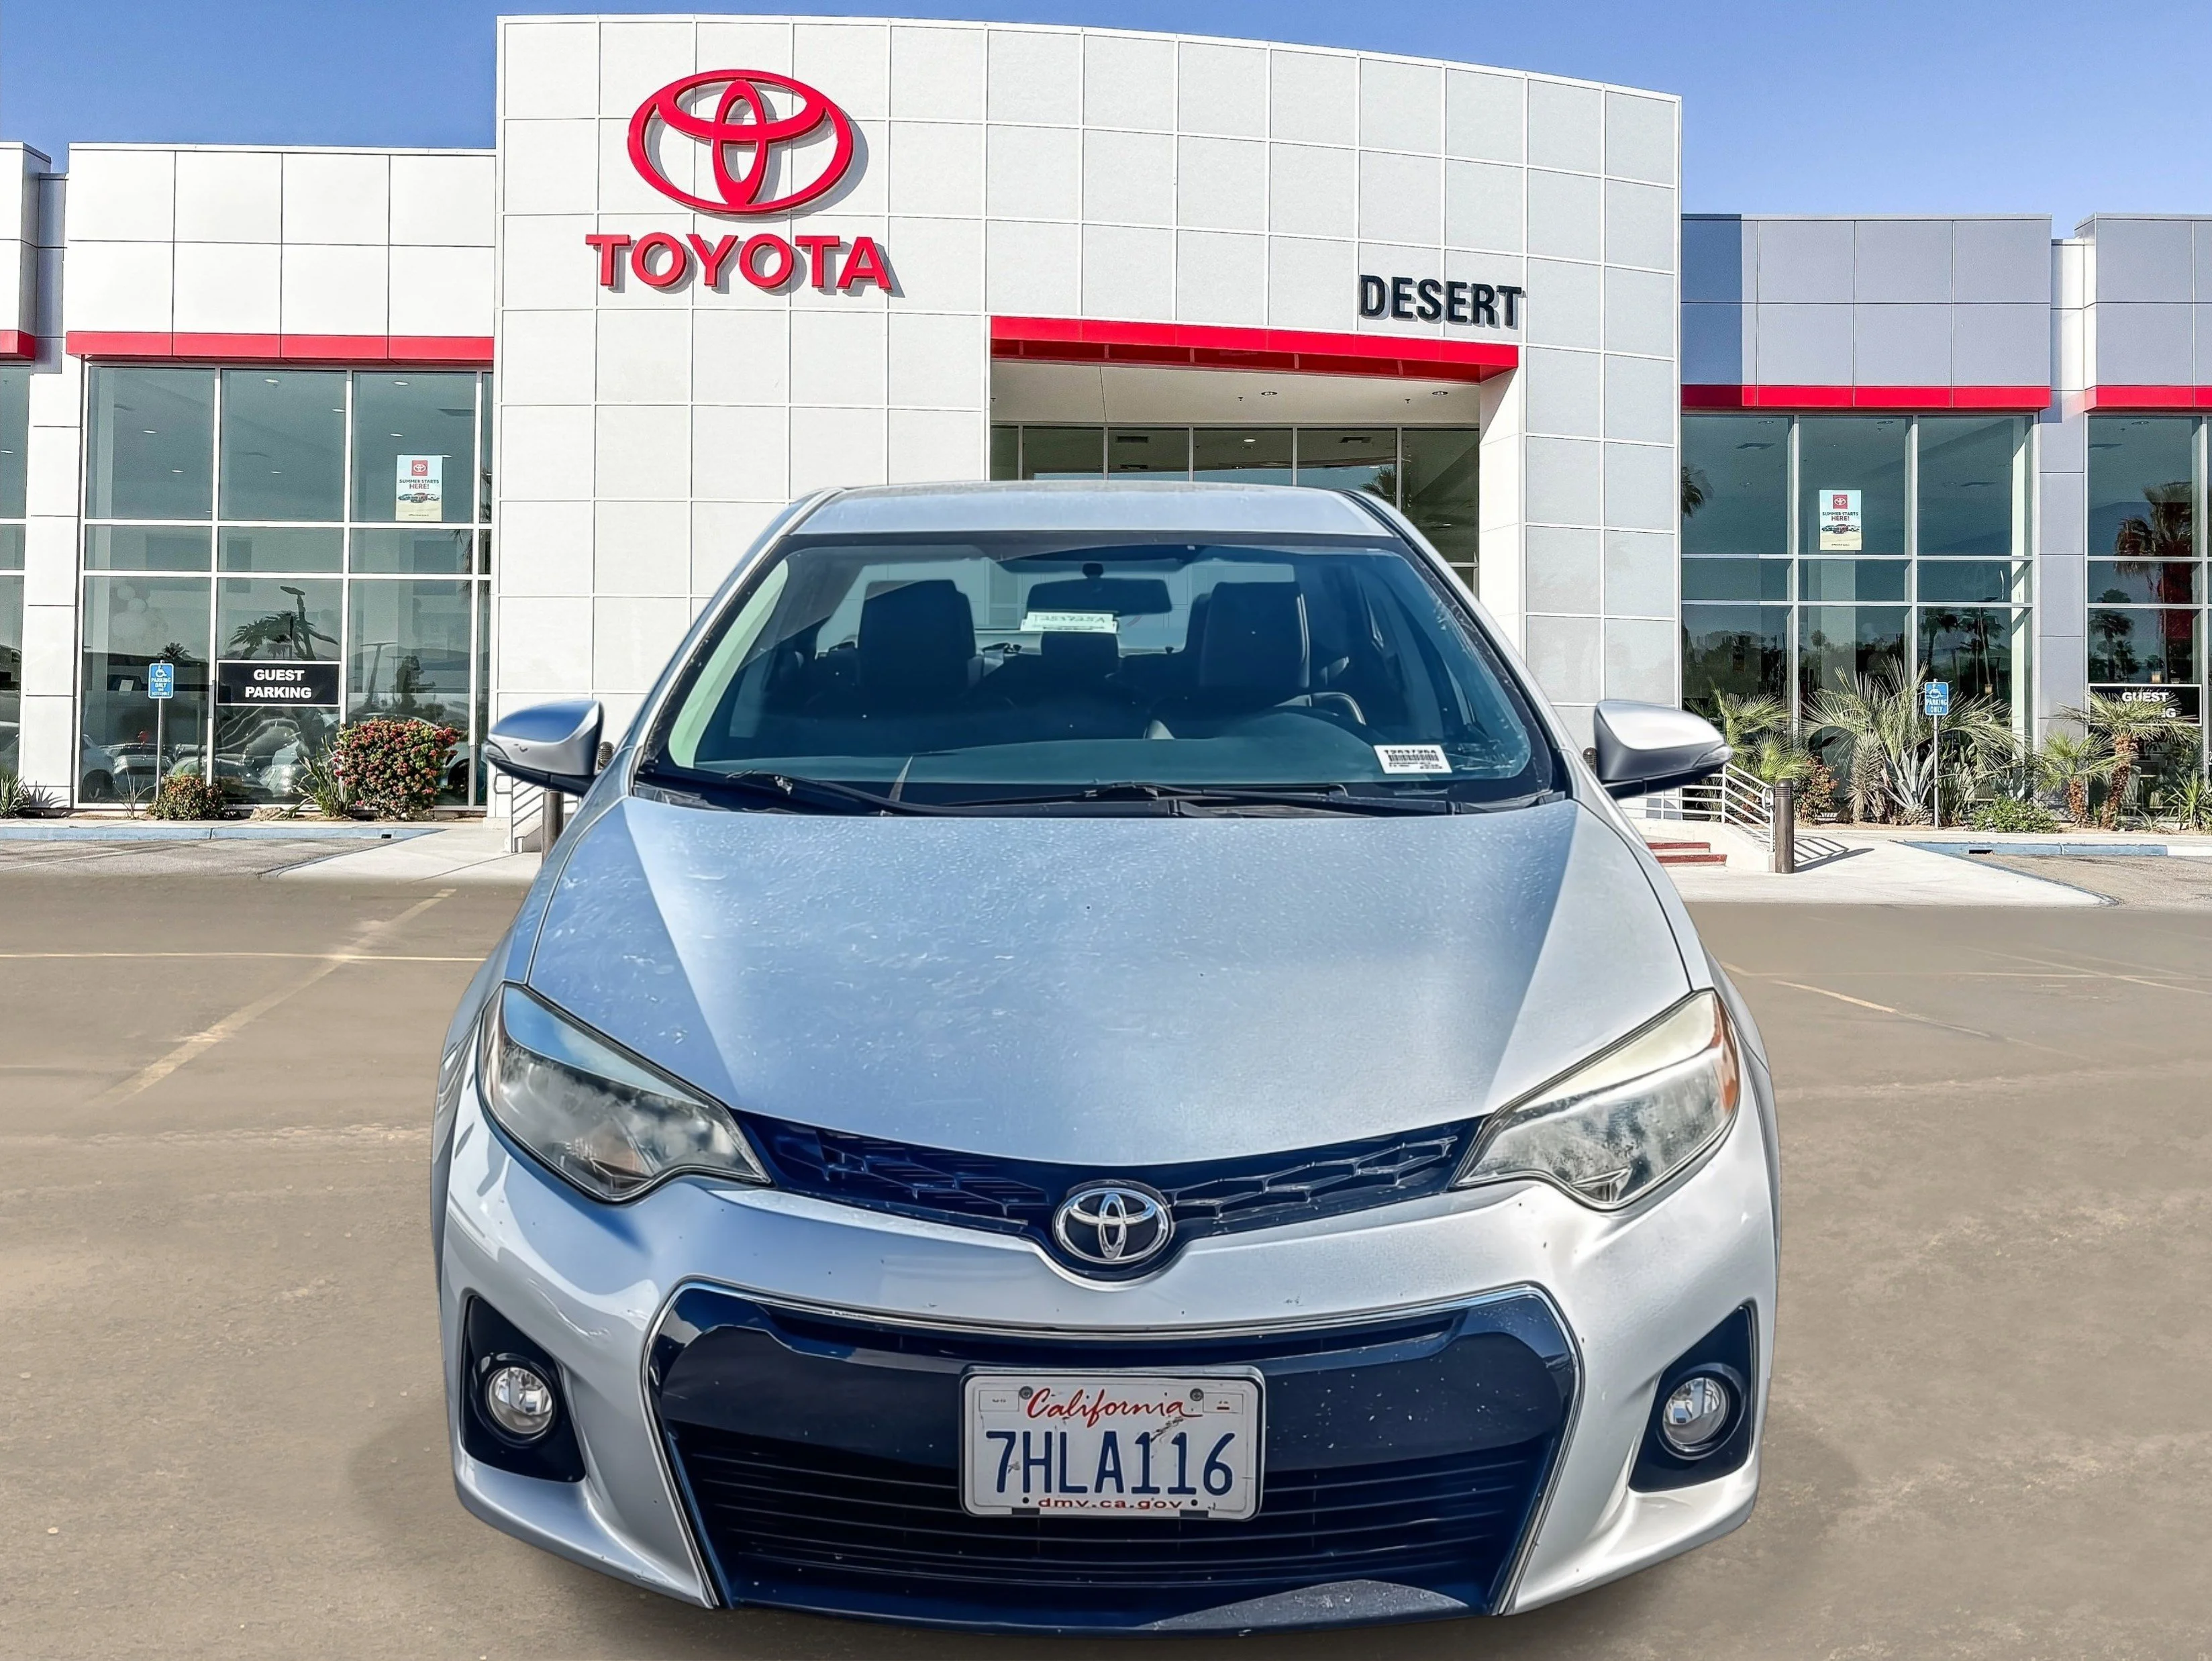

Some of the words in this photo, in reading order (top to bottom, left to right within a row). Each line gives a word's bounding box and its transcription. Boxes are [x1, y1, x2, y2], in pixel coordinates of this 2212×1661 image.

[585, 232, 892, 291] TOYOTA
[1359, 274, 1522, 326] DESERT
[253, 669, 305, 681] GUEST
[245, 687, 312, 699] PARKING
[2121, 691, 2169, 703] GUEST
[1027, 1388, 1203, 1427] California
[986, 1431, 1236, 1496] 7HLA116
[1038, 1497, 1183, 1510] dmv.ca.gov
